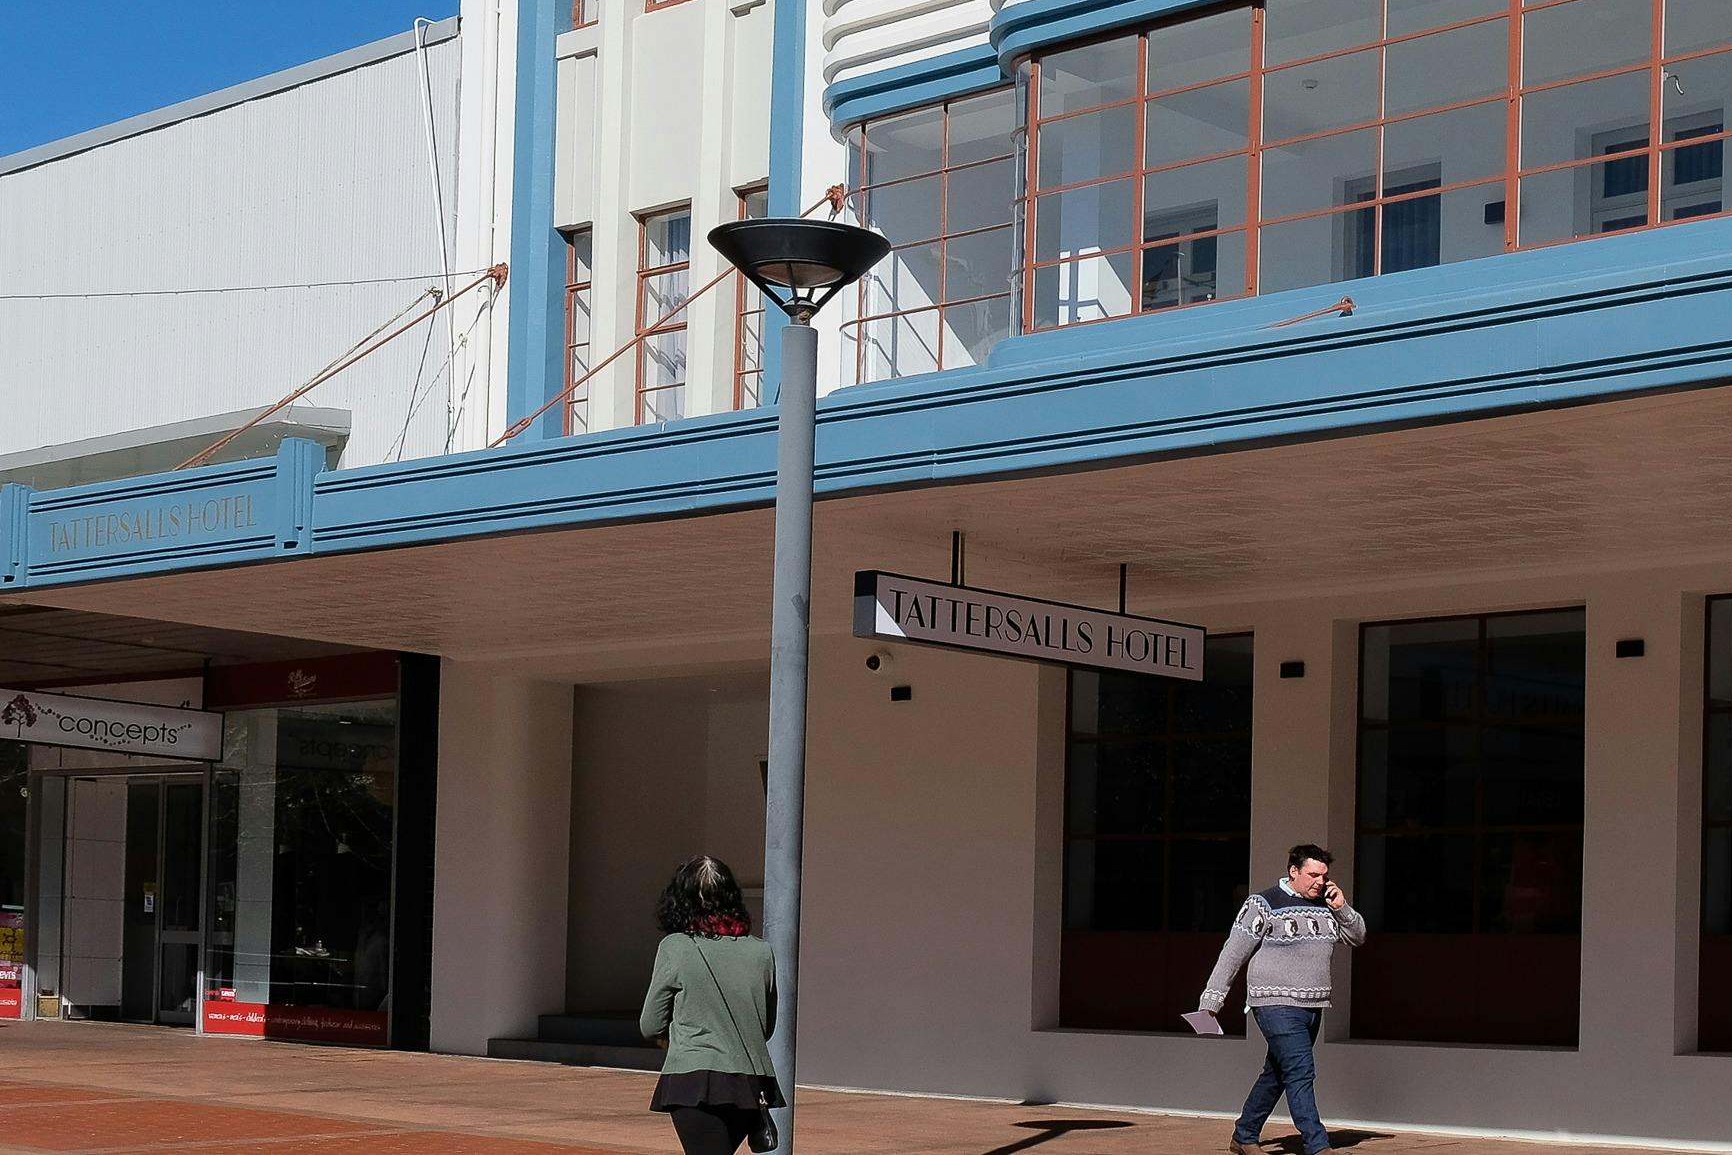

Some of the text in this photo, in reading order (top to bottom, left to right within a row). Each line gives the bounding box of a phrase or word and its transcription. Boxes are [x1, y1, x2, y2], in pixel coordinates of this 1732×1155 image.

[50, 495, 257, 552] TATTERSALLS HOTEL
[889, 589, 1195, 670] TATTERSALLS HOTEL
[58, 715, 178, 746] concepts
